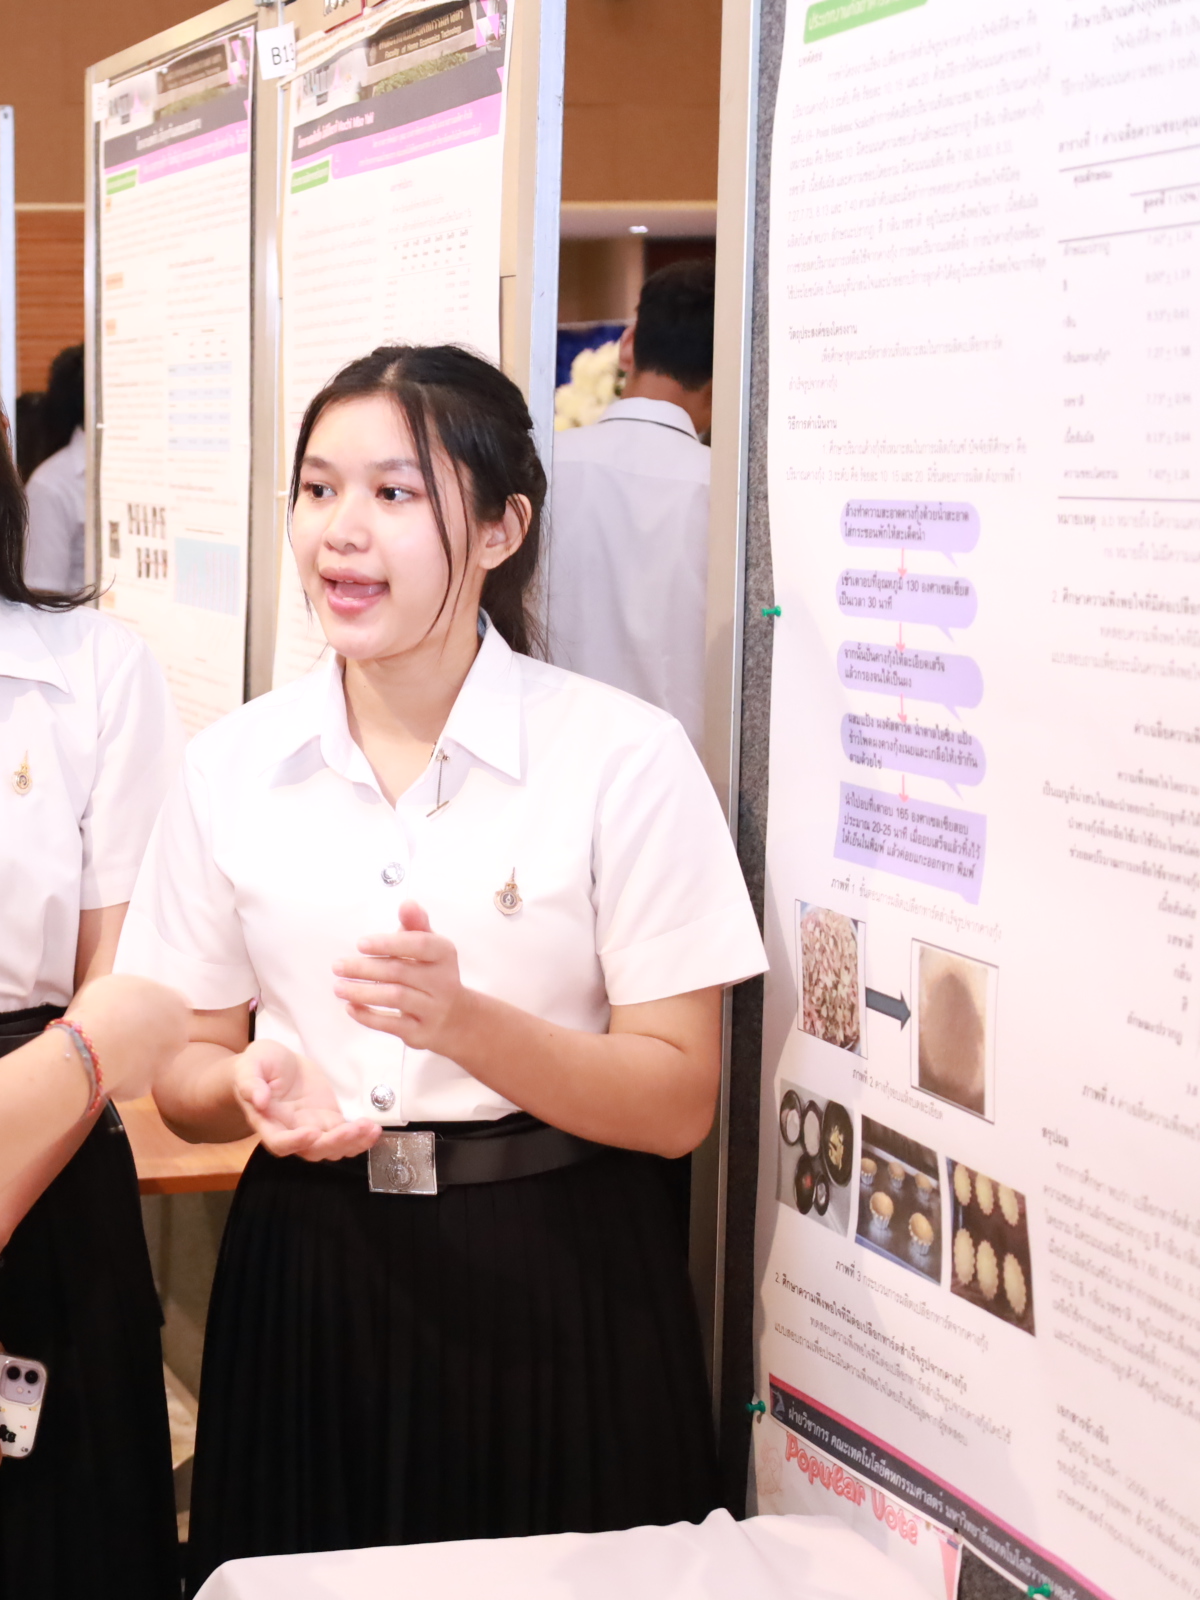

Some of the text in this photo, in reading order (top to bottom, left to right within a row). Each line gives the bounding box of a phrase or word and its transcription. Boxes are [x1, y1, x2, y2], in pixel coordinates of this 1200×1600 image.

[906, 580, 919, 592] 130
[868, 596, 877, 608] 30
[896, 807, 909, 820] 165
[872, 821, 892, 836] 20-25
[788, 1402, 829, 1442] ฝ่ายวิชาการ
[785, 1431, 866, 1507] Popular
